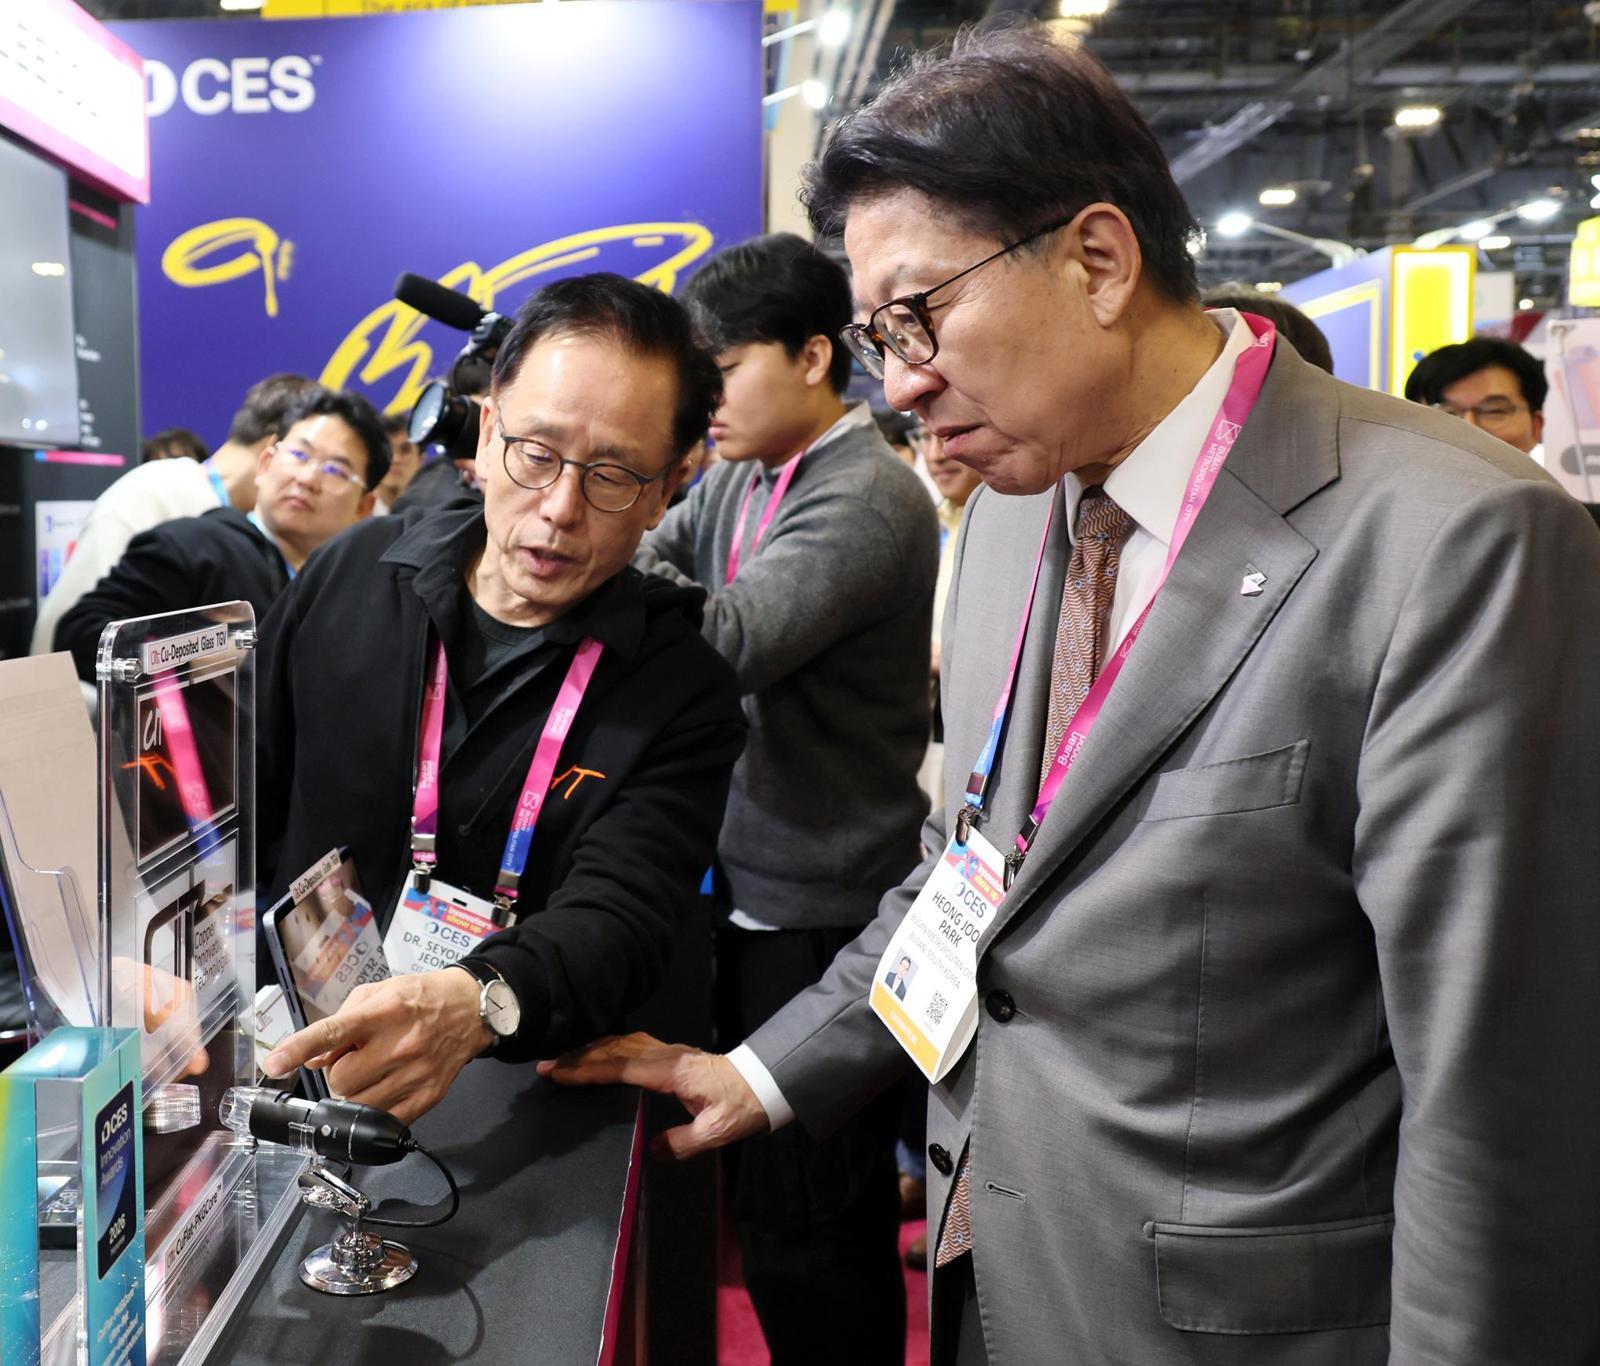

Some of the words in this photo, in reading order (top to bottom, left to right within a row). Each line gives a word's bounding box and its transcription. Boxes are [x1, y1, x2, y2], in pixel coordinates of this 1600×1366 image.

[181, 55, 316, 116] CES
[200, 636, 215, 651] Glass
[216, 631, 227, 647] TGV
[1057, 731, 1079, 767] Busan
[932, 891, 963, 926] HEONG
[960, 920, 980, 943] JOO
[963, 890, 987, 919] CES
[403, 932, 422, 947] DR.
[440, 926, 471, 948] CES
[938, 920, 963, 948] PARK
[110, 1102, 128, 1134] CES
